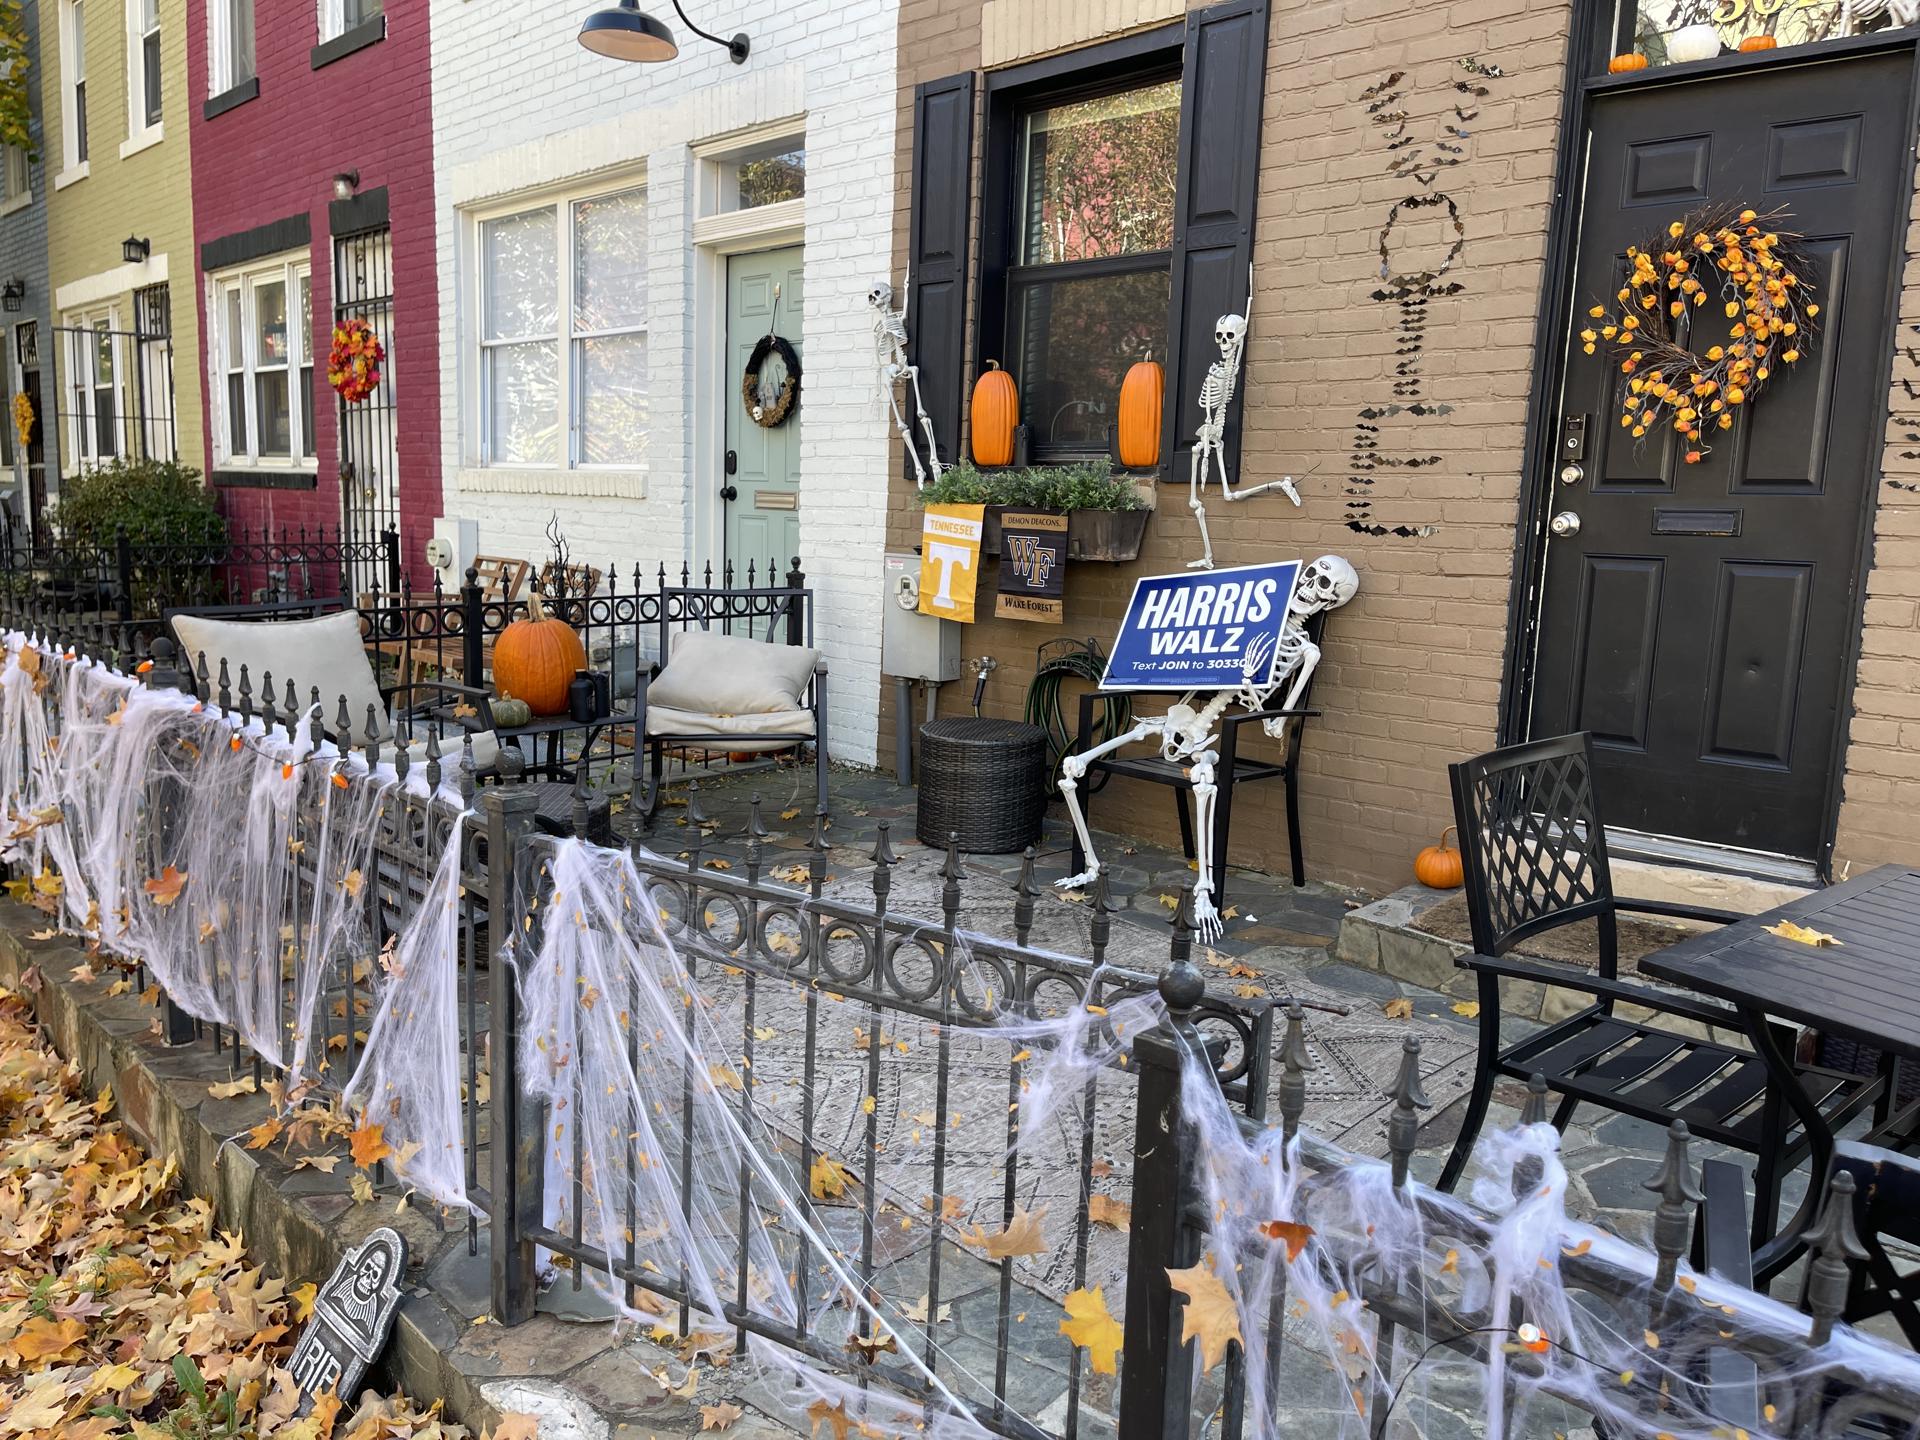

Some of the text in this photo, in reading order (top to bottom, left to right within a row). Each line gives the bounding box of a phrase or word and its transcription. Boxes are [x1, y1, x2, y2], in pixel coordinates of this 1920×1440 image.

[930, 519, 975, 537] TENNESSEE
[1008, 516, 1031, 525] DEMON
[929, 542, 971, 609] T
[1008, 535, 1055, 587] WF
[1137, 578, 1277, 629] HARRIS
[1150, 627, 1245, 656] WALZ
[1132, 659, 1247, 670] Text JOIN to 30330
[294, 1336, 342, 1393] RIP
